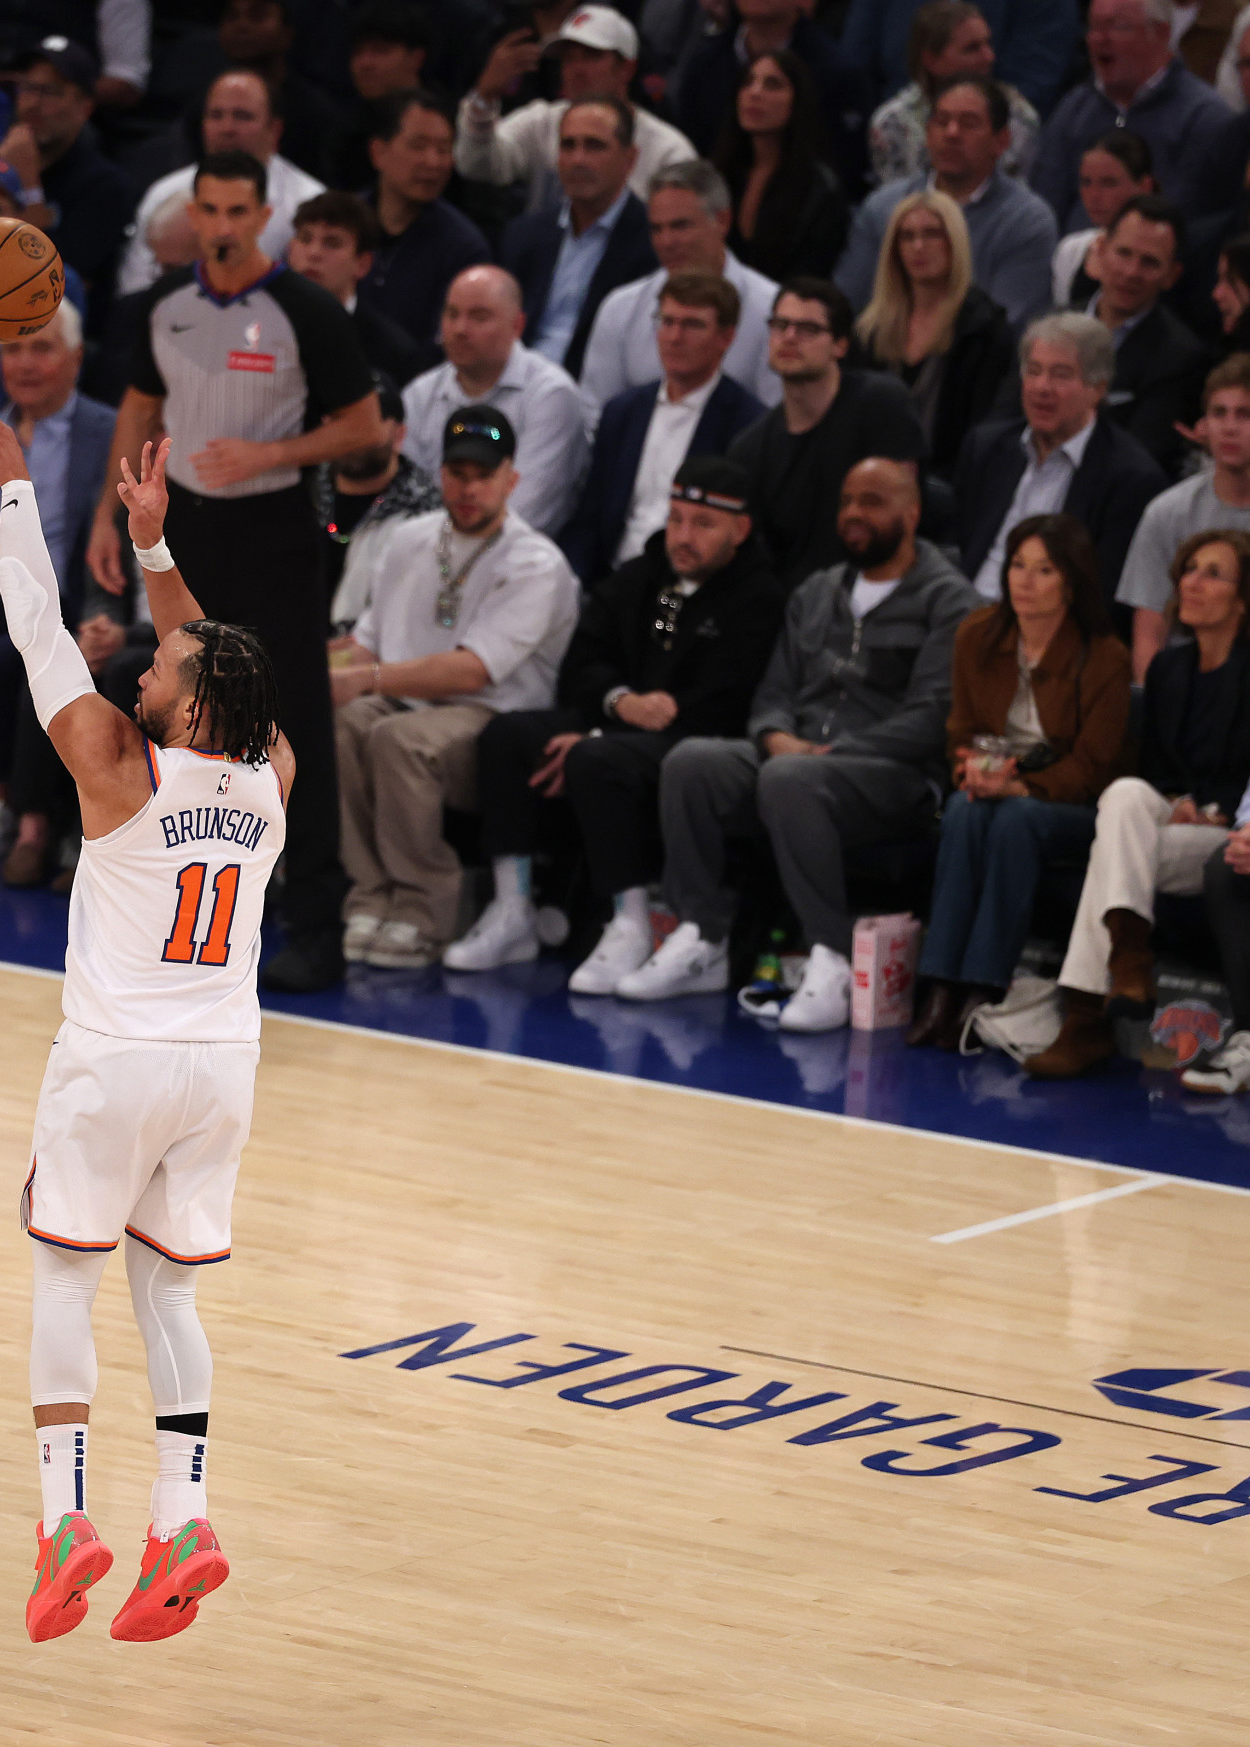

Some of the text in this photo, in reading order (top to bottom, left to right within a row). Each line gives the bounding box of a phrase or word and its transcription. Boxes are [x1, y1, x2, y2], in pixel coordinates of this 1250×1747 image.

[159, 806, 270, 852] BRUNSON
[160, 862, 241, 967] 11
[337, 1321, 1062, 1477] GARDEN
